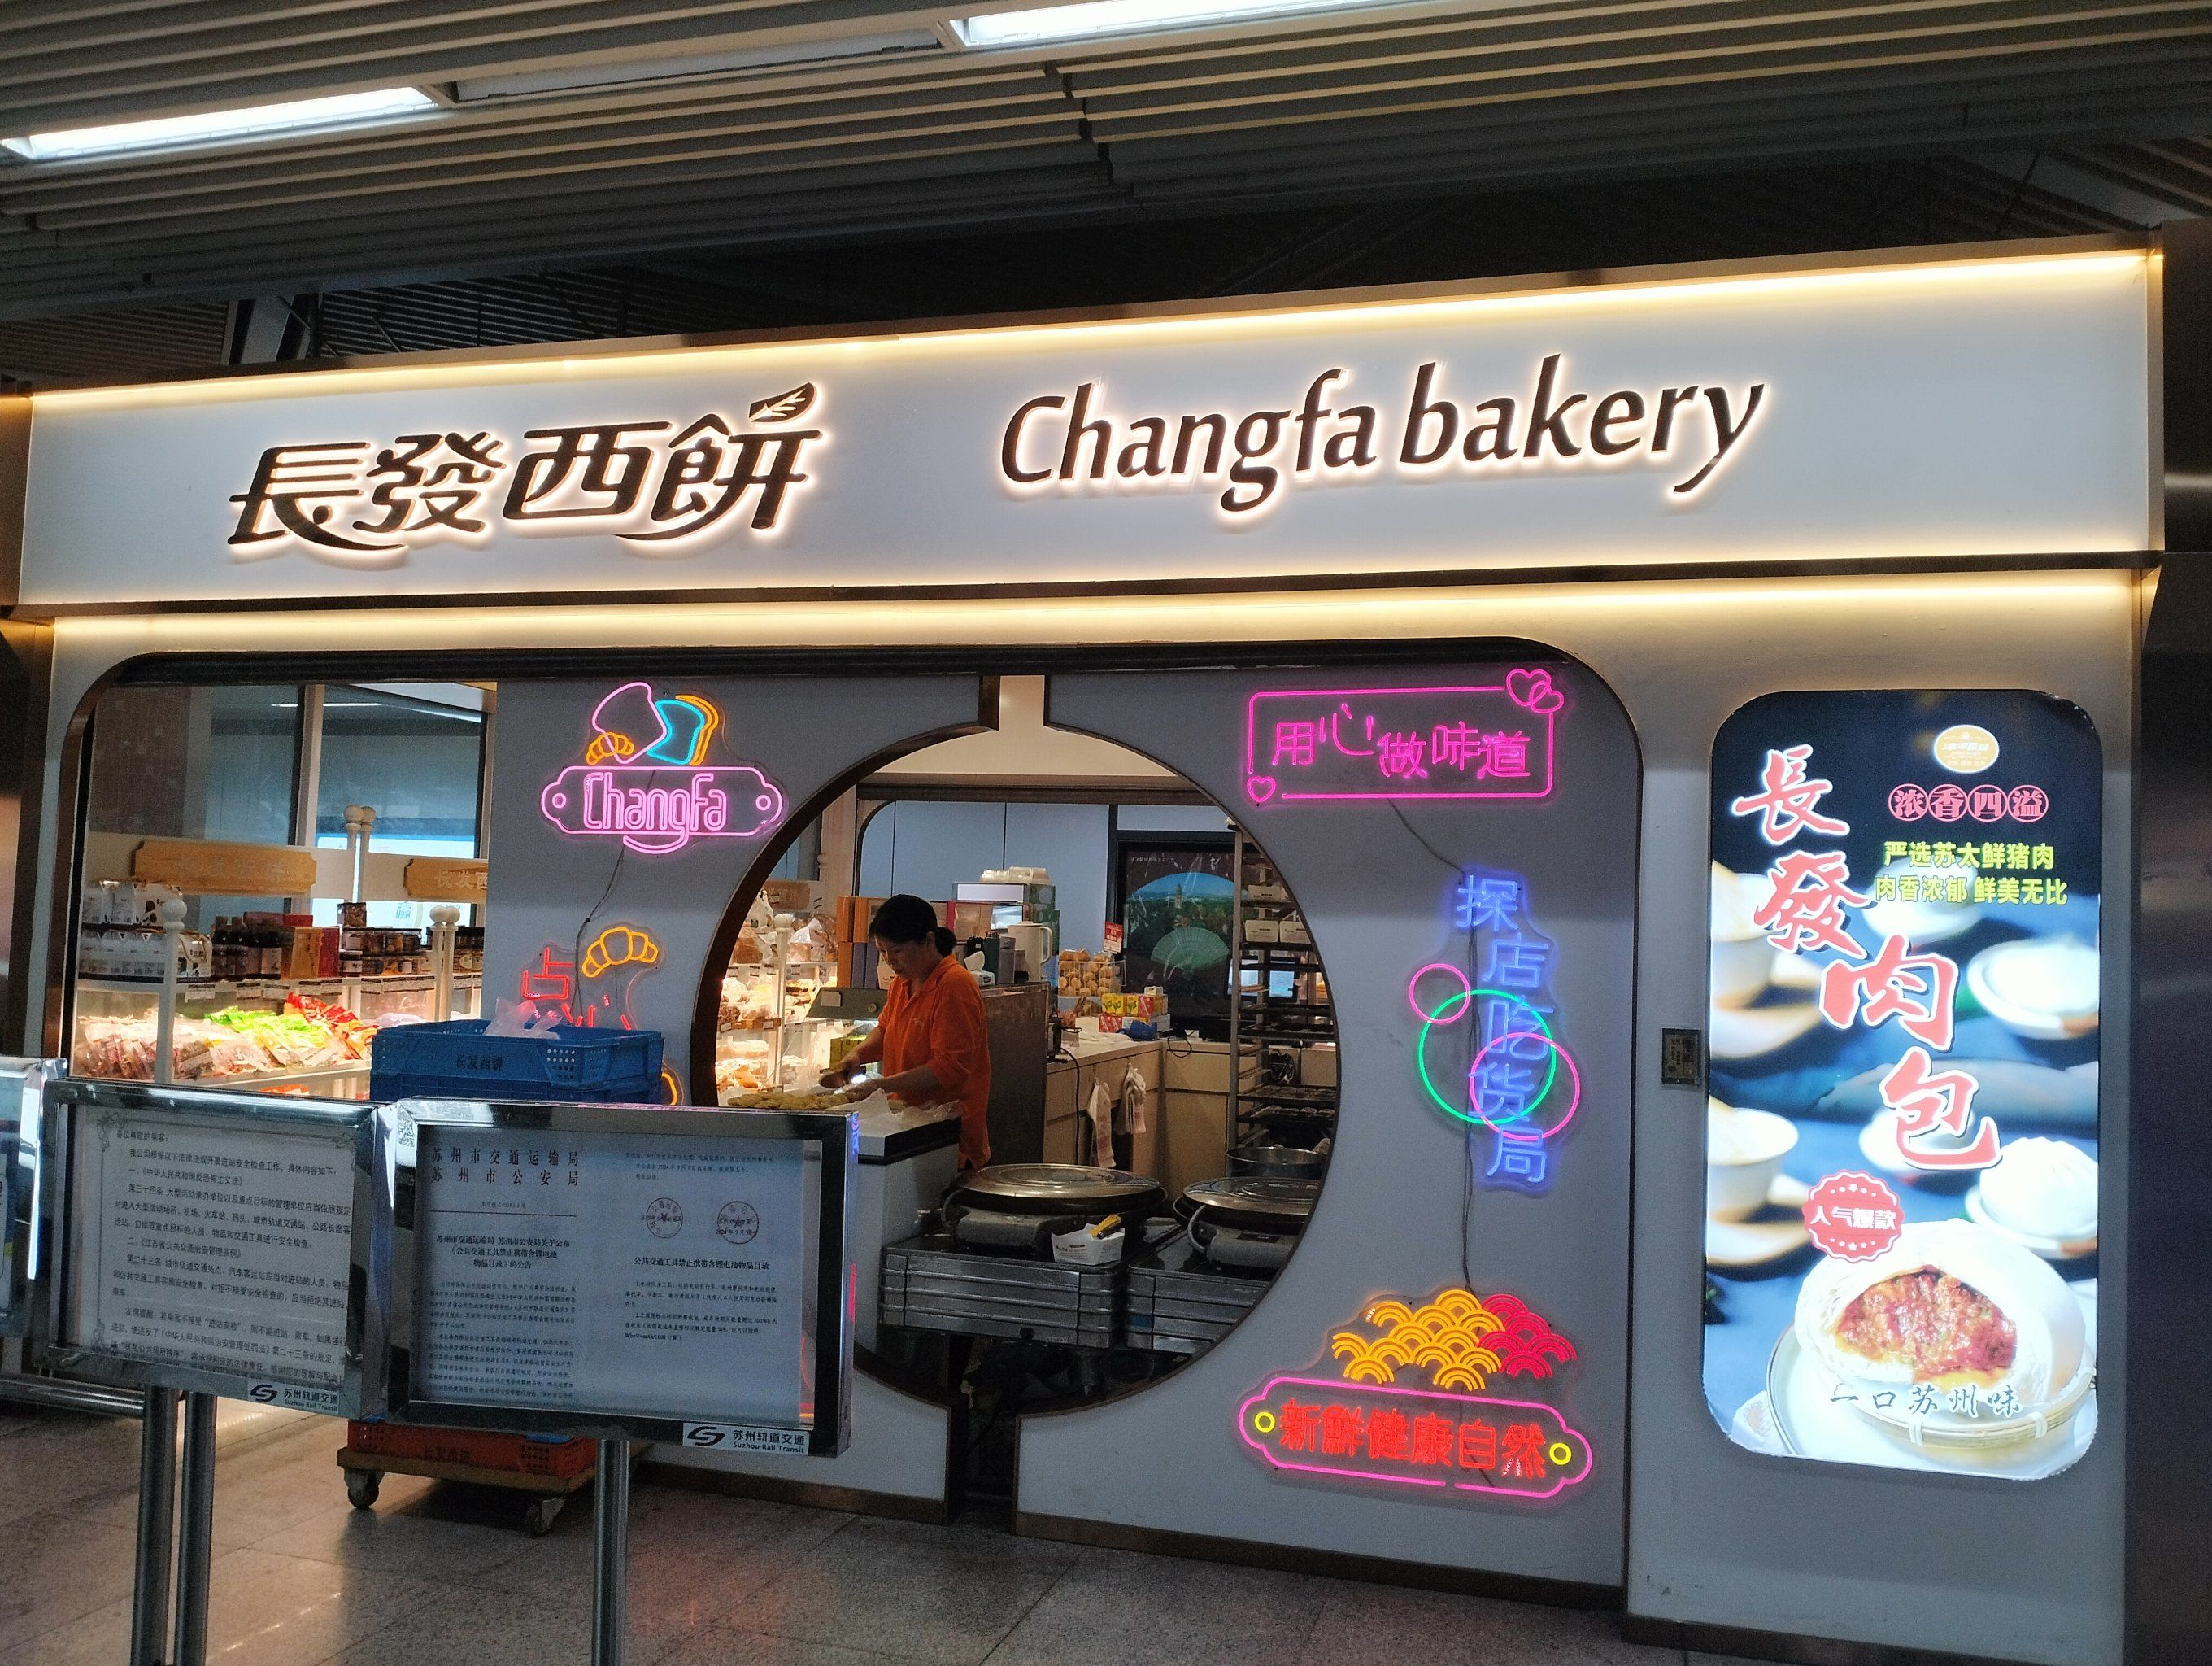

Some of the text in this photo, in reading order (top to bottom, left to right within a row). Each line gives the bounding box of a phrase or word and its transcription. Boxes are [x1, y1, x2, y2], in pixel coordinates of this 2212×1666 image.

[1003, 354, 1766, 513] Changfa bakery
[227, 382, 821, 551] 長發西餅
[1273, 704, 1531, 779] 用心做味道
[584, 772, 726, 854] Changfa
[1890, 785, 2047, 821] 浓香四溢
[1884, 841, 2055, 870] 严选苏太鲜猪肉
[1875, 874, 2068, 905] 肉香浓郁 鲜美无比
[1456, 874, 1553, 1184] 探店吃货局
[431, 1147, 578, 1167] 苏州市交通运输局
[431, 1167, 578, 1186] 苏州市公安局
[1810, 1205, 1896, 1230] 人气爆款
[285, 1388, 338, 1404] 苏州轨道交通
[1830, 1385, 2023, 1418] 一口苏州味
[732, 1429, 805, 1446] 苏州轨道交通
[733, 1441, 760, 1450] Suzhou
[778, 1446, 804, 1454] Transit
